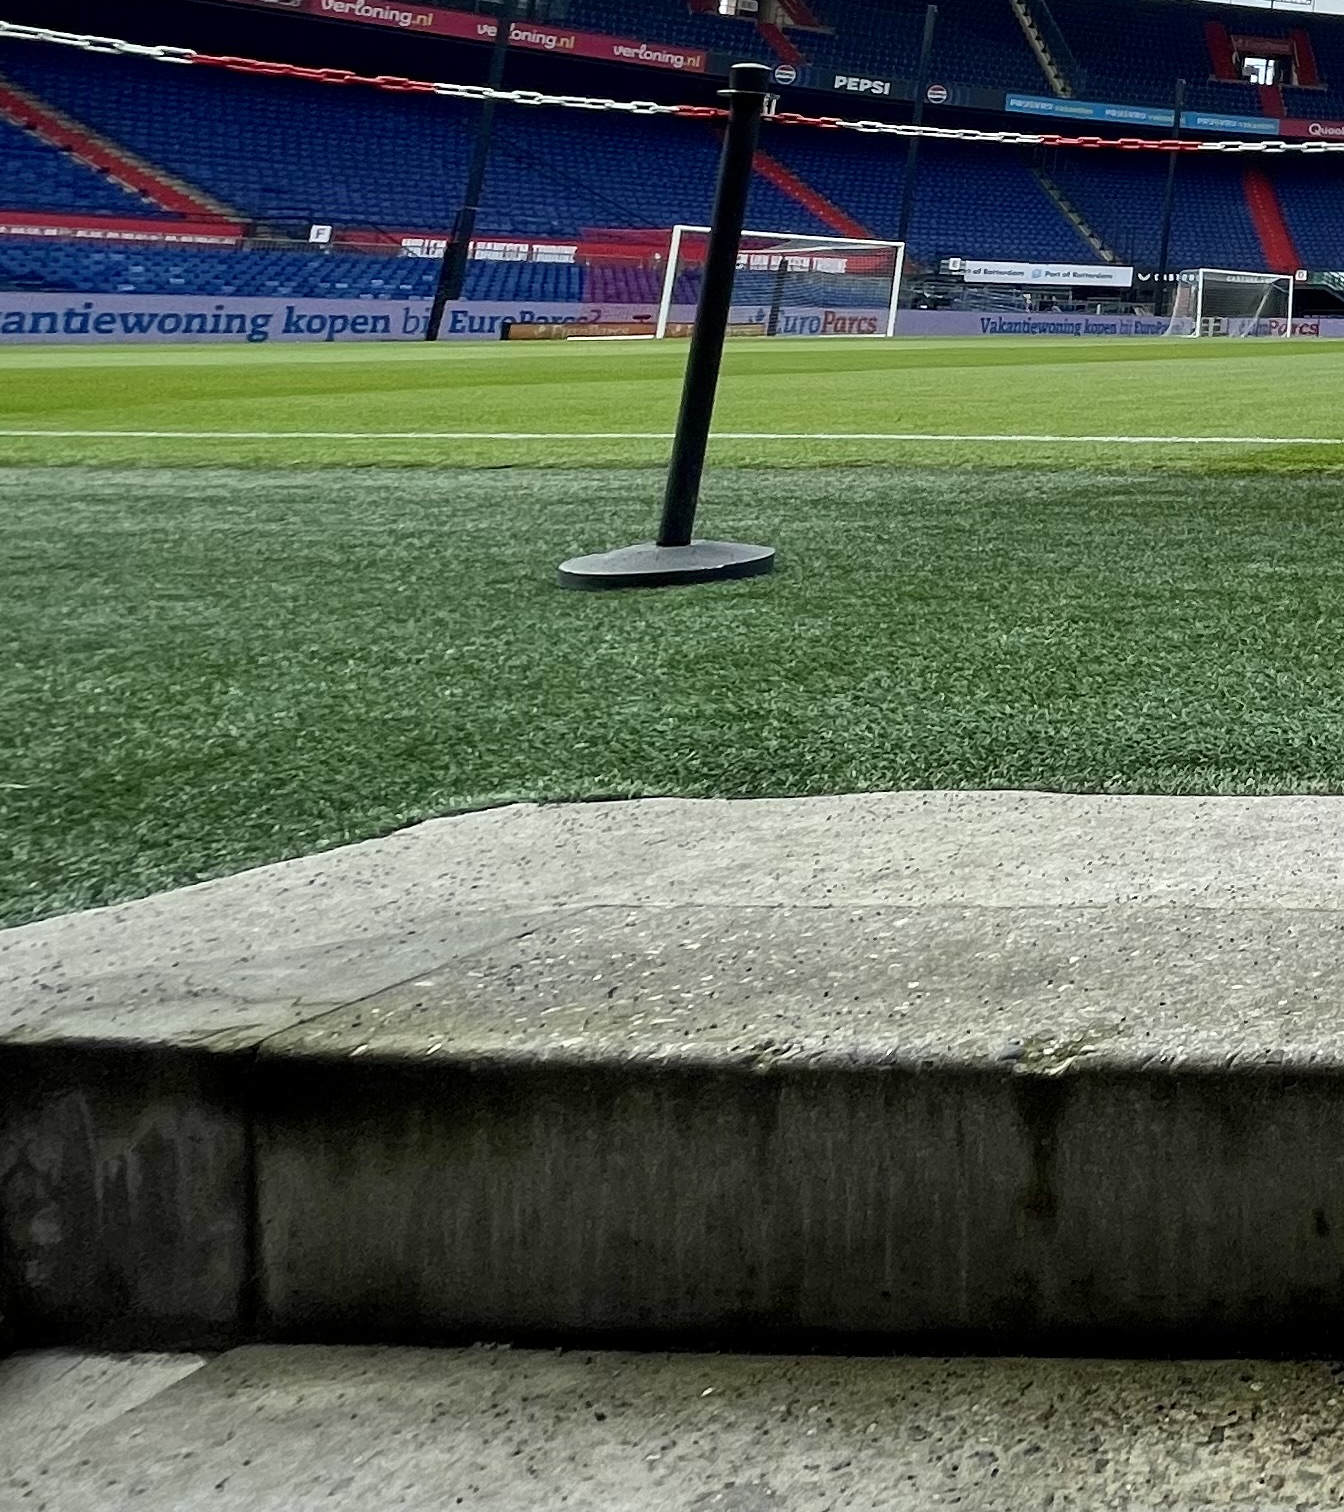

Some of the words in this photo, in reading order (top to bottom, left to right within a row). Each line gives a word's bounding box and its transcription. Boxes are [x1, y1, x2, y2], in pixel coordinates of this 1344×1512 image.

[477, 22, 574, 49] veloning.nl
[613, 43, 700, 68] verloning.nl
[834, 76, 891, 95] PEPSI
[0, 302, 272, 343] antiewoning
[283, 306, 391, 341] kopen
[980, 317, 1082, 336] Vakantiewoning
[1084, 318, 1117, 336] kopen
